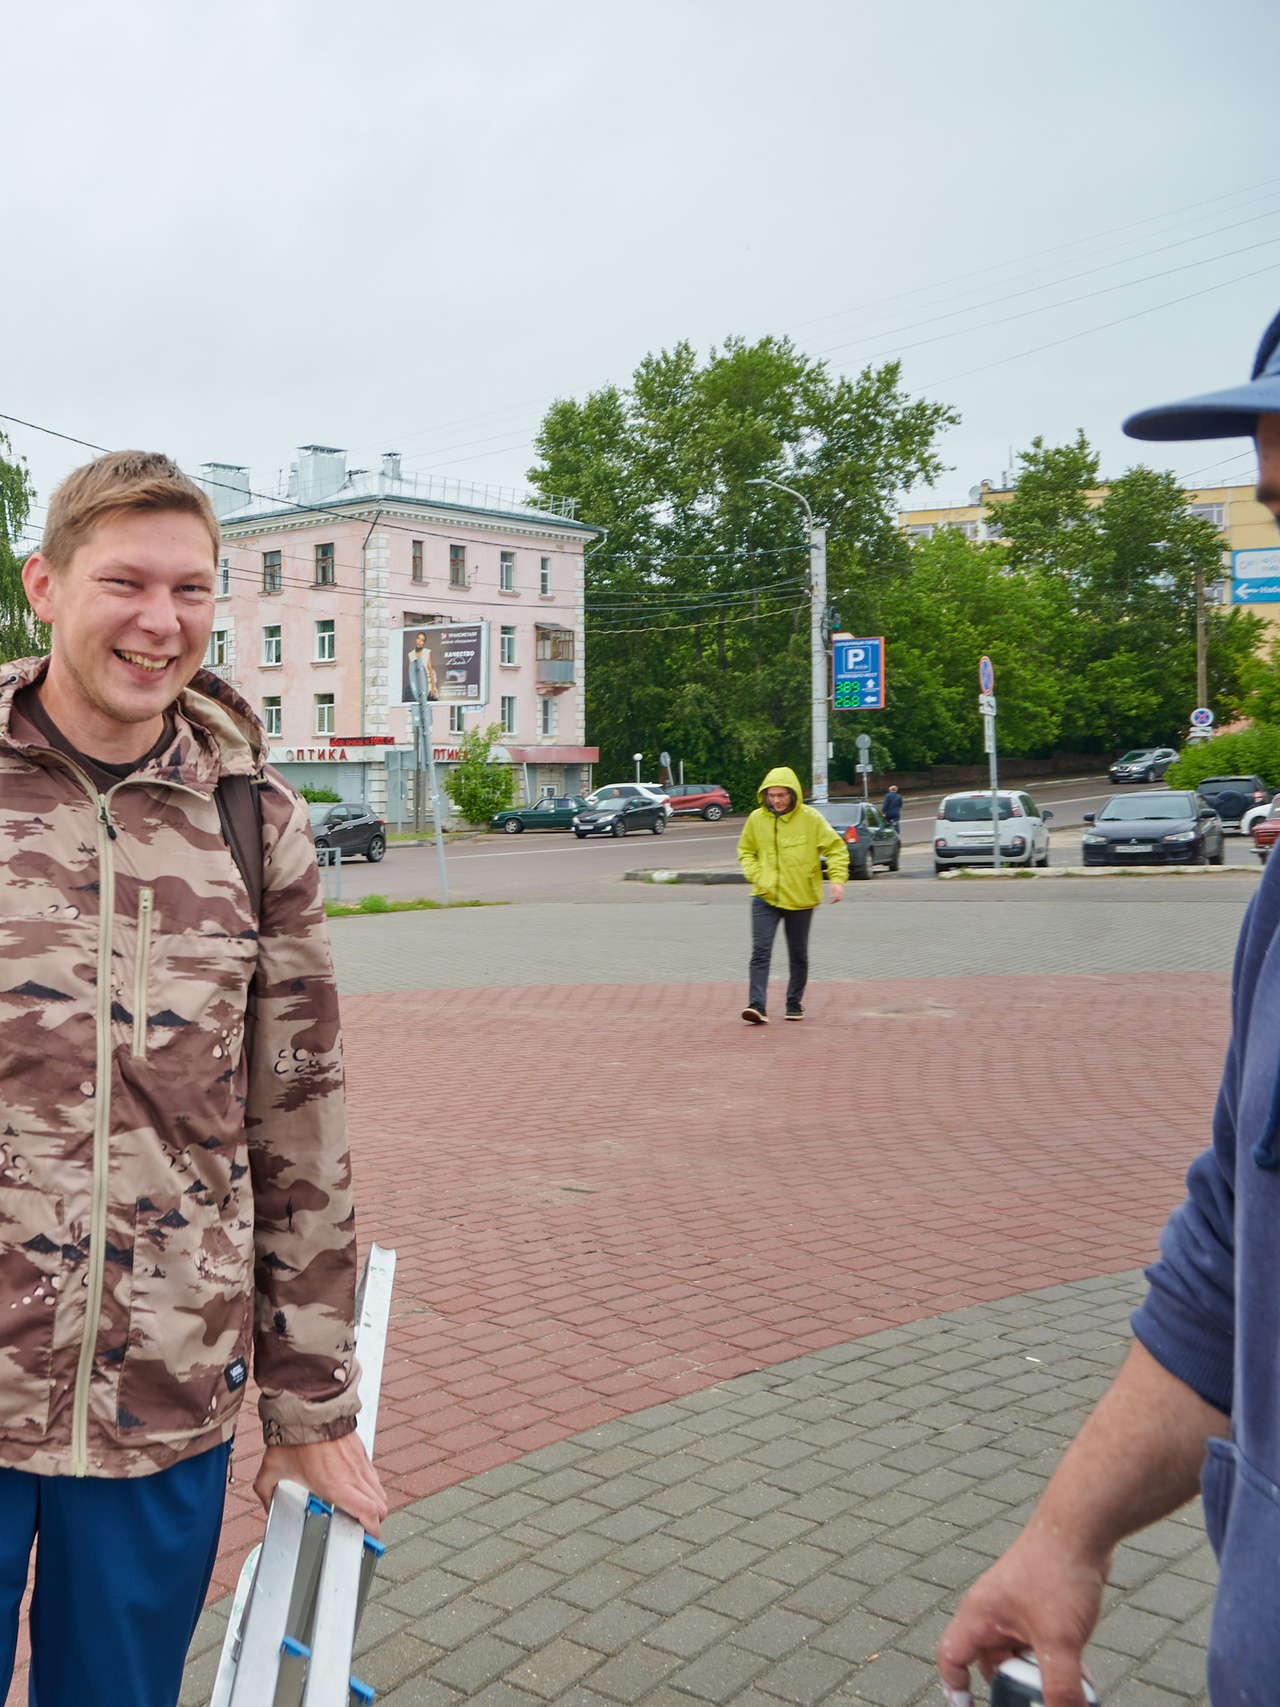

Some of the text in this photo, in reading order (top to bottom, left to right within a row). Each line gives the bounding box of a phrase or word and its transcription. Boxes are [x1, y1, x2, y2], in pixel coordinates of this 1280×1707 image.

[444, 650, 475, 658] КАЧЕСТВО
[847, 649, 865, 670] P
[836, 681, 860, 693] 389
[835, 695, 860, 707] 268
[286, 748, 348, 761] ОПТИКА
